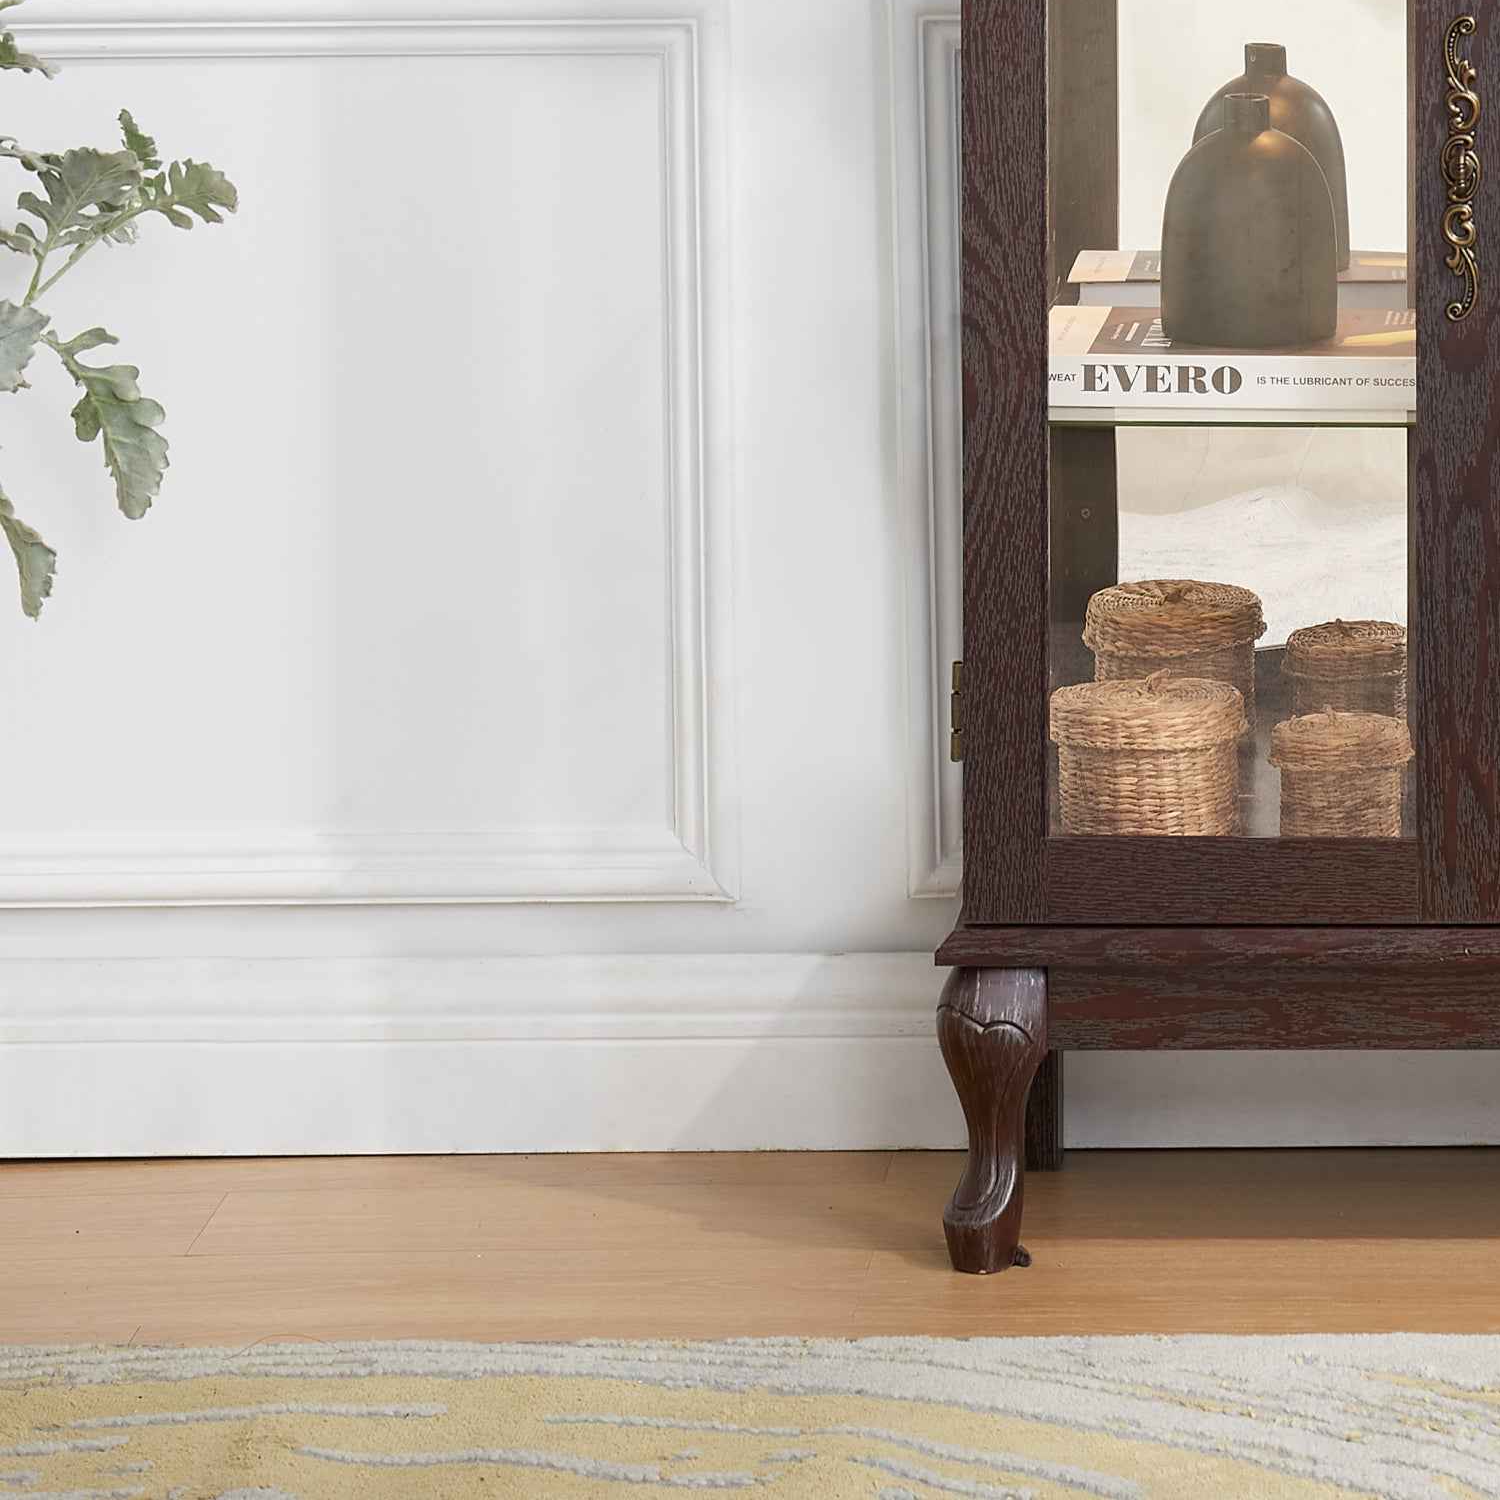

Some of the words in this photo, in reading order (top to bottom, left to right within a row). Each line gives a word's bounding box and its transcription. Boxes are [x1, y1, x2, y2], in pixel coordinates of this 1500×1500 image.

[1080, 362, 1243, 395] EVERO
[1256, 376, 1266, 385] IS
[1269, 376, 1289, 385] THE
[1293, 376, 1352, 387] LUBRICANT
[1355, 377, 1370, 387] OF
